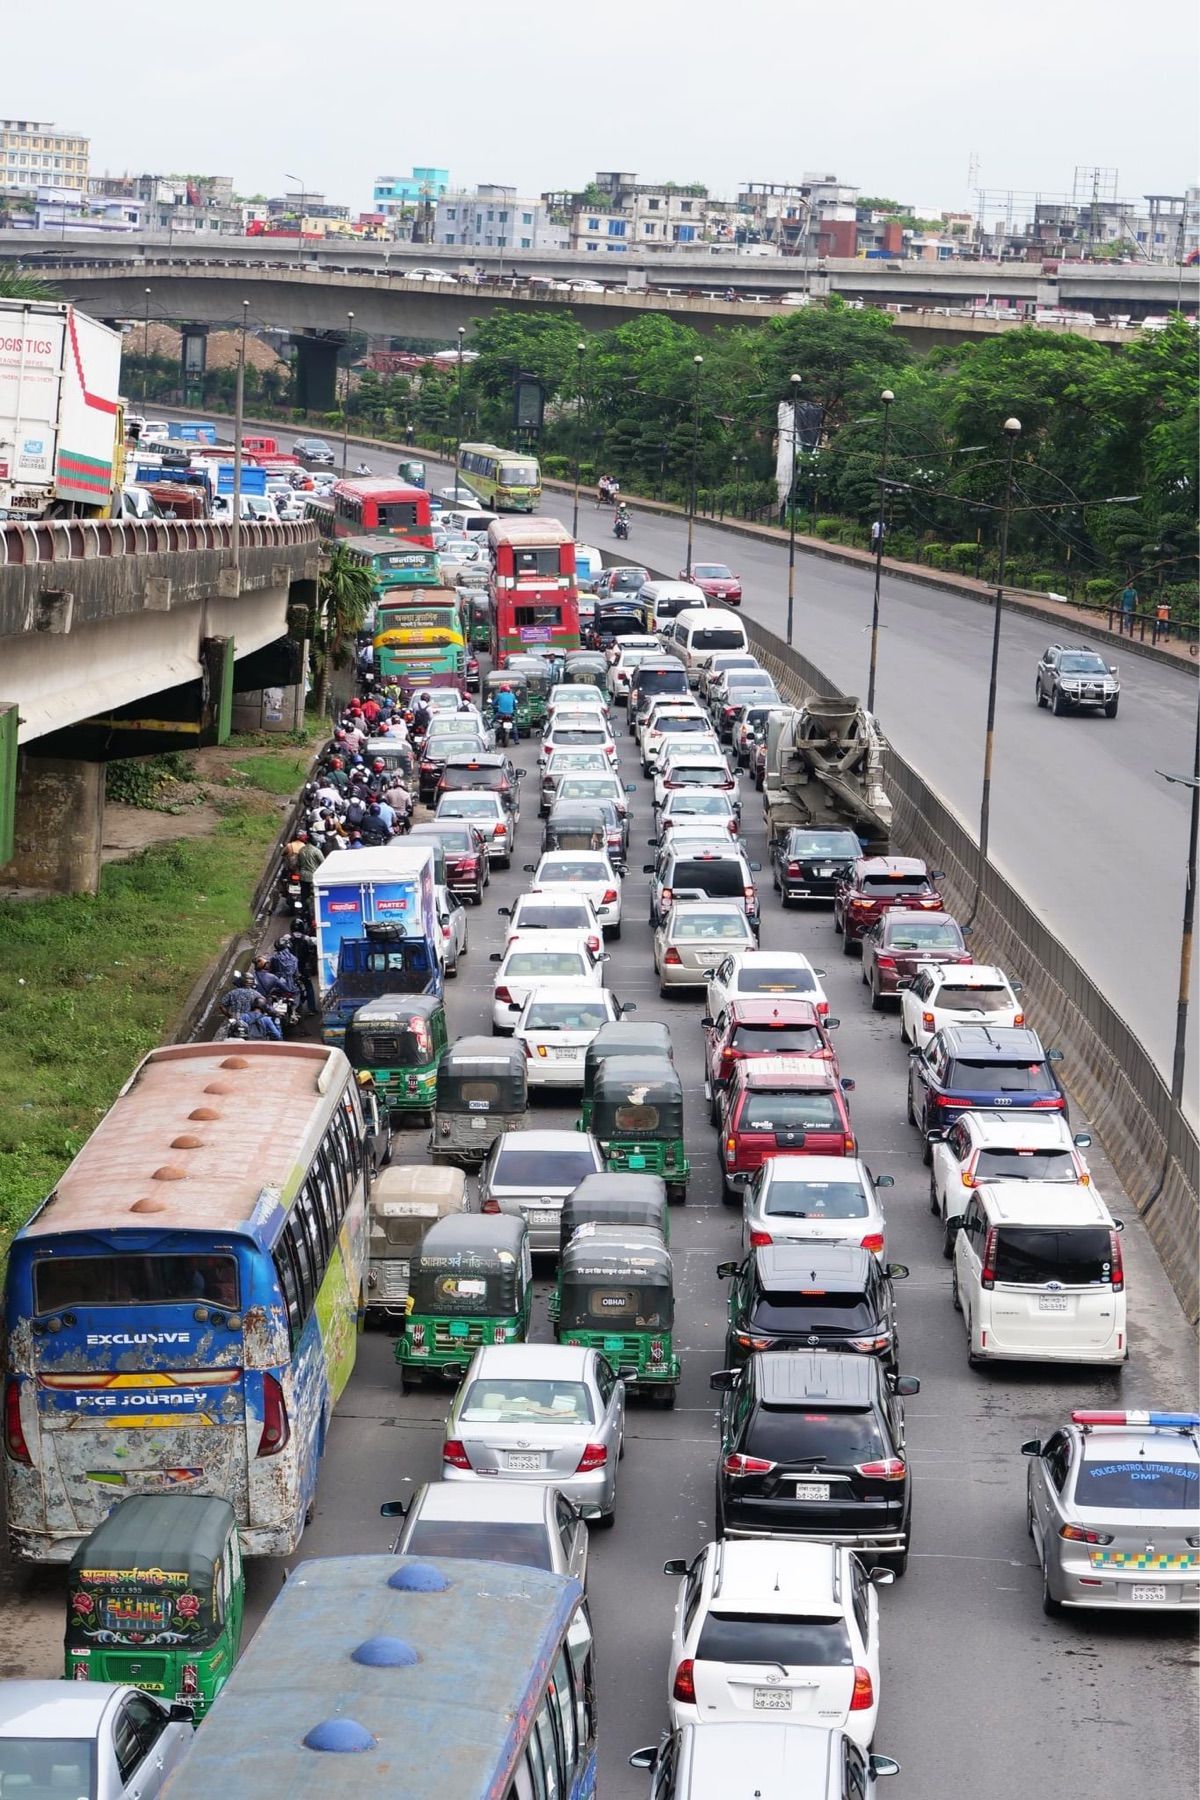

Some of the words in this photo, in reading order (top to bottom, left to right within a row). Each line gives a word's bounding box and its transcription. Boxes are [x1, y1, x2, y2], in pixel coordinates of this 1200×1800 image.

[121, 1393, 208, 1405] JOURNEY
[1090, 1464, 1117, 1478] POLICE
[1117, 1463, 1145, 1471] PATROL
[1146, 1463, 1174, 1474] UTTARA
[1174, 1468, 1199, 1481] (EAST)
